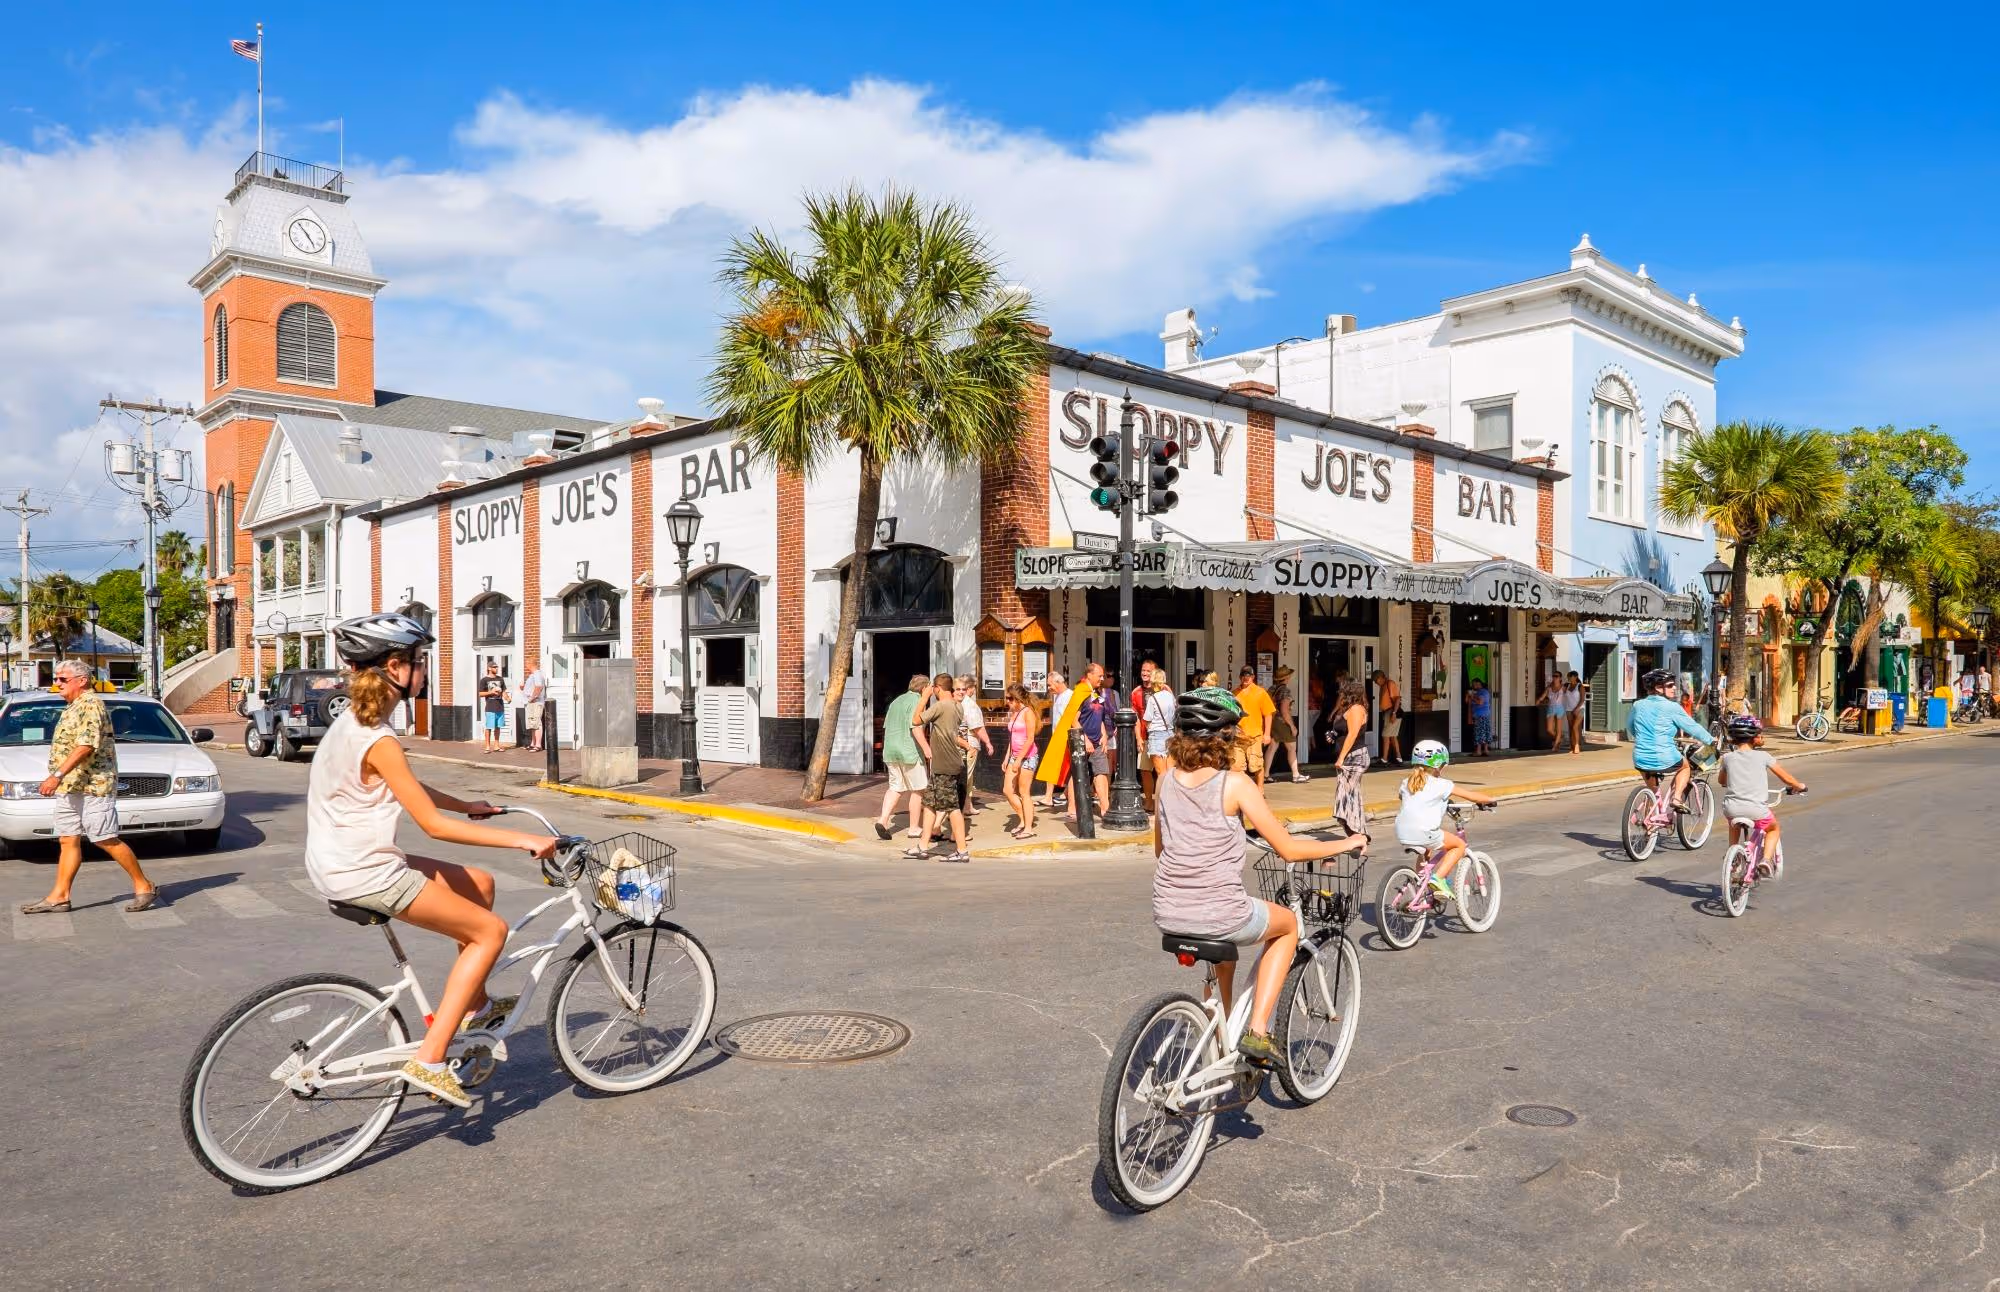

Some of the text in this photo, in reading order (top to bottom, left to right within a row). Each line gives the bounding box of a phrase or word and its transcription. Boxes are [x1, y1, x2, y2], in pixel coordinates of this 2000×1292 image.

[680, 441, 752, 501] BAR
[1301, 444, 1391, 503] JOE'S
[552, 472, 618, 526] JOE'S
[1458, 475, 1516, 526] BAR
[455, 495, 524, 546] SLOPPY
[1084, 537, 1102, 547] Duval
[1133, 551, 1166, 571] BAR
[1200, 558, 1258, 582] Cocktails
[1274, 558, 1379, 591] SLOPPY
[1488, 579, 1542, 606] JOE'S
[1620, 593, 1649, 615] BAR
